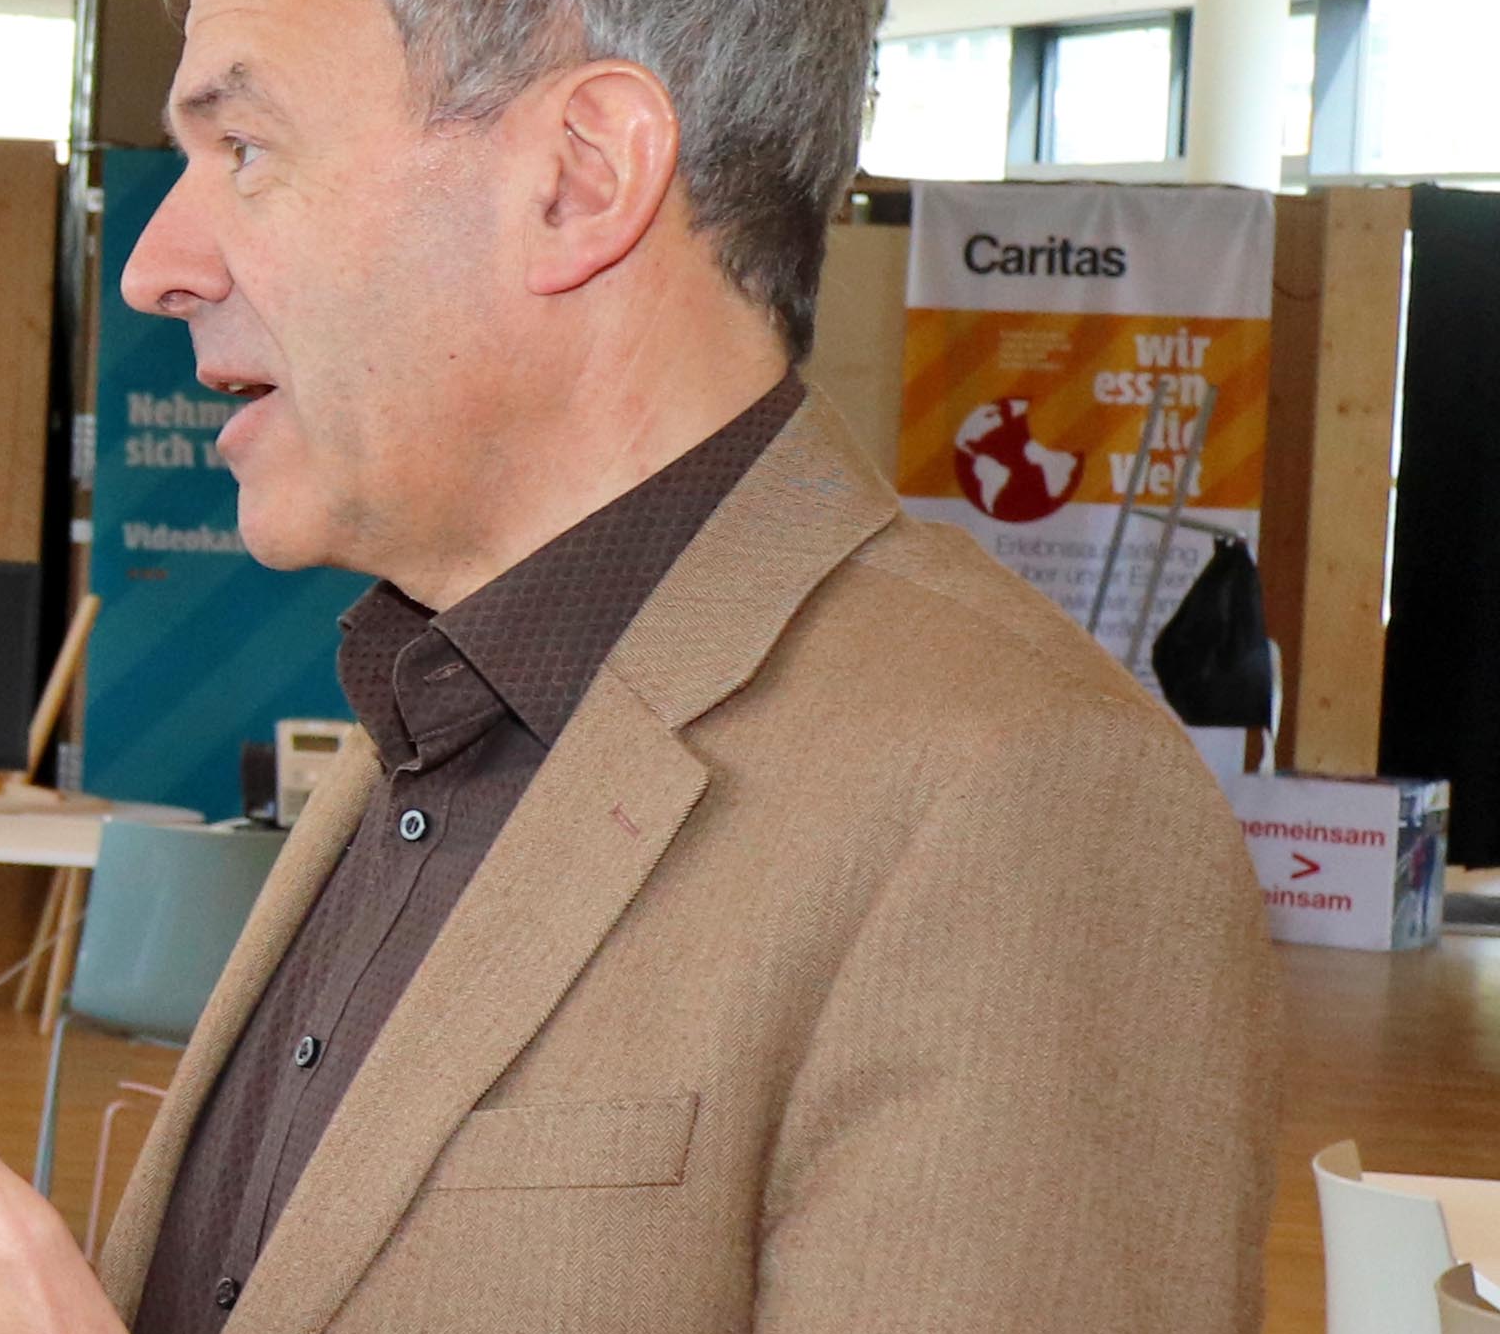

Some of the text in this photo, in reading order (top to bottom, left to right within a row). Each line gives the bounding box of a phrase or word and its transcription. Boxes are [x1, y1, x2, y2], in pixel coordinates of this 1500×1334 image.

[963, 233, 1127, 278] Caritas
[1134, 326, 1213, 369] wir
[1093, 369, 1209, 407] essen
[126, 391, 246, 428] Nehm
[124, 432, 195, 469] sich
